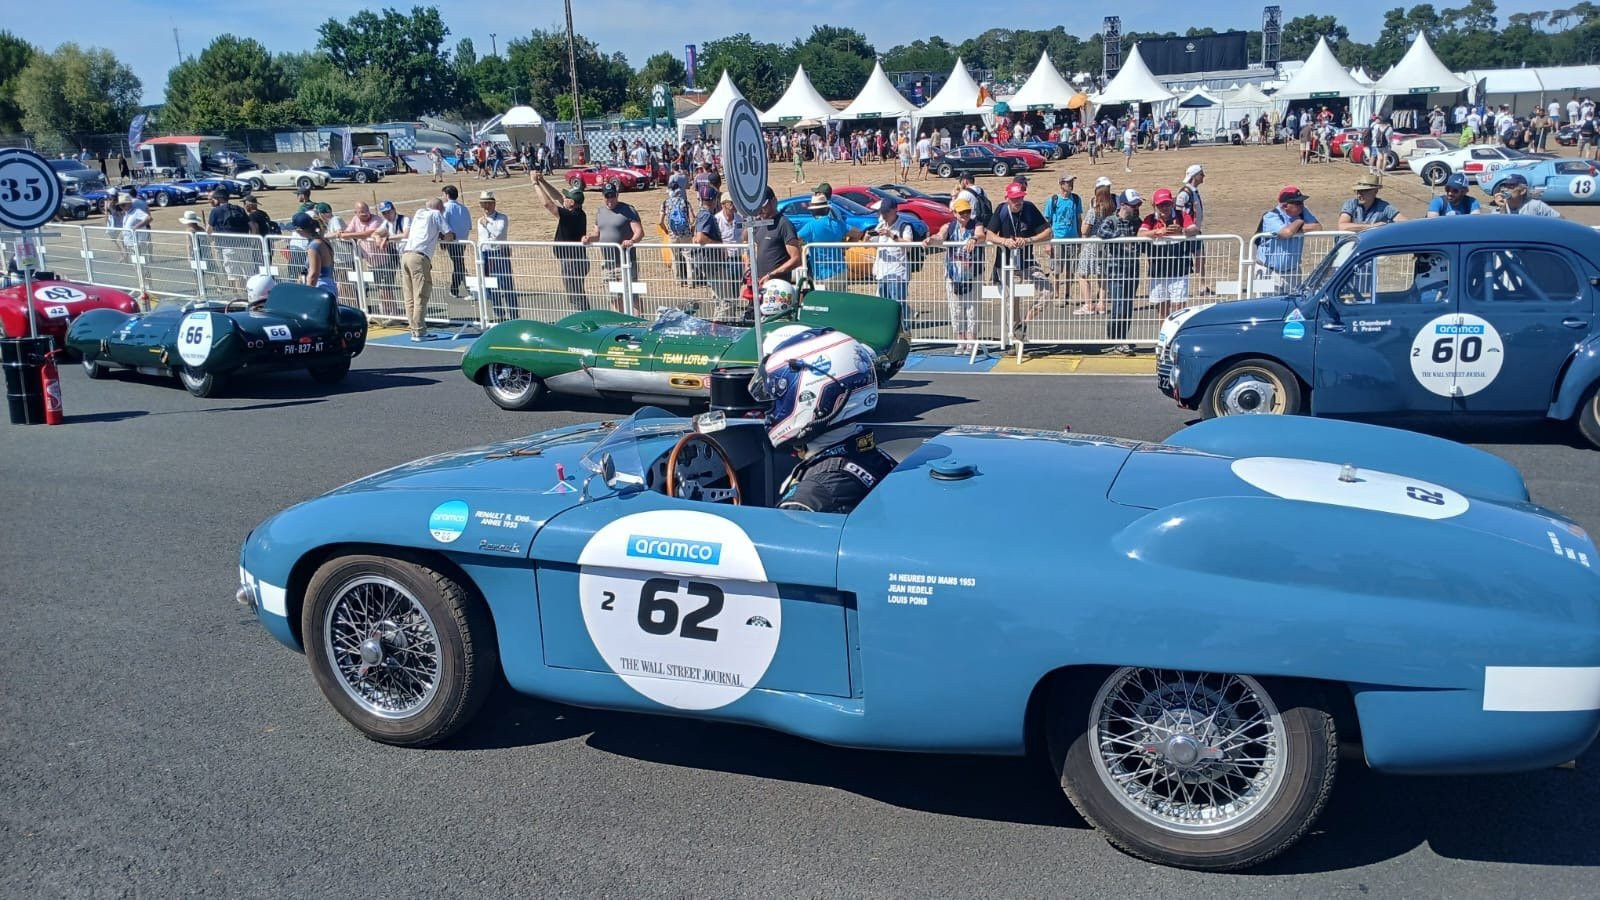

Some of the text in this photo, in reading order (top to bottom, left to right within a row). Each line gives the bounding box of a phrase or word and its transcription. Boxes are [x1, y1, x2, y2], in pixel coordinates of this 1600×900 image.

[738, 141, 759, 176] 36
[0, 178, 42, 202] 35
[1575, 181, 1591, 194] 13
[44, 287, 81, 300] 42
[186, 326, 204, 345] 66
[270, 325, 287, 337] 66
[1440, 324, 1480, 334] aramco
[1412, 348, 1421, 357] 2
[1432, 336, 1482, 363] 60
[662, 353, 709, 365] TEAM LOTUS
[1406, 486, 1445, 506] 62
[475, 510, 504, 520] RENAULT
[635, 538, 713, 560] aramco
[888, 573, 897, 581] 24
[898, 574, 926, 583] HEURES
[926, 576, 937, 584] DU
[959, 577, 976, 587] 1953
[888, 584, 934, 595] JEAN REDELE
[601, 590, 616, 611] 2
[887, 595, 928, 605] LOUIS PONS
[637, 577, 725, 642] 62
[620, 657, 743, 686] THE WALL STREET JOURNAL
